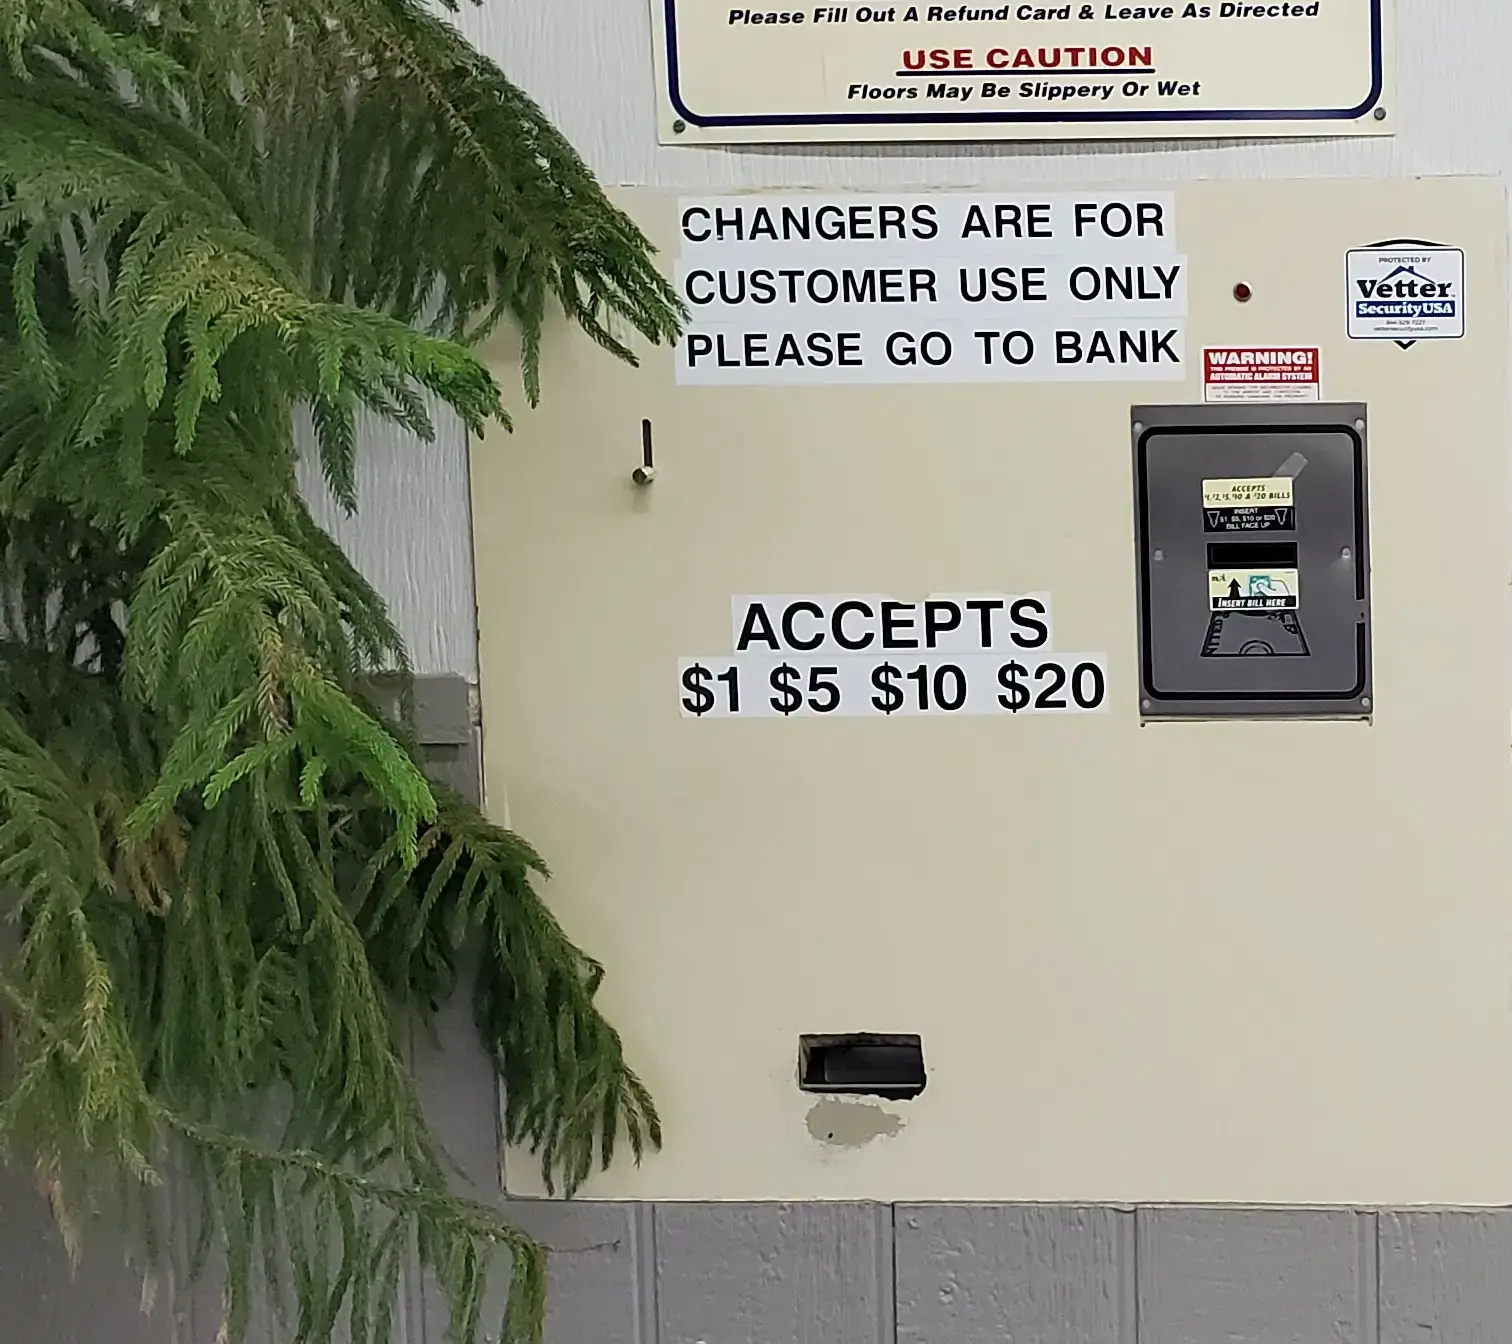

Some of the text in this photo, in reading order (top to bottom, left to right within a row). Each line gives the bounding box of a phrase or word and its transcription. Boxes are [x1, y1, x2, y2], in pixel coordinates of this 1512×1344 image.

[729, 2, 1319, 24] Please Fill Out A Refund Card & Leave As Directed
[904, 47, 1151, 69] USE CAUTION
[848, 81, 1200, 101] Floors May Be Slippery Or Wet
[682, 203, 1163, 241] CHANGERS ARE FOR
[686, 266, 1180, 304] CUSTOMER USE ONLY
[1356, 280, 1452, 298] Vetter
[1358, 302, 1452, 317] SecurityUSA
[688, 330, 1180, 367] PLEASE GO TO BANK
[1209, 352, 1313, 364] WARNING!
[737, 599, 1047, 650] ACCEPTS
[682, 660, 1104, 716] $1 $5 $10 $20
